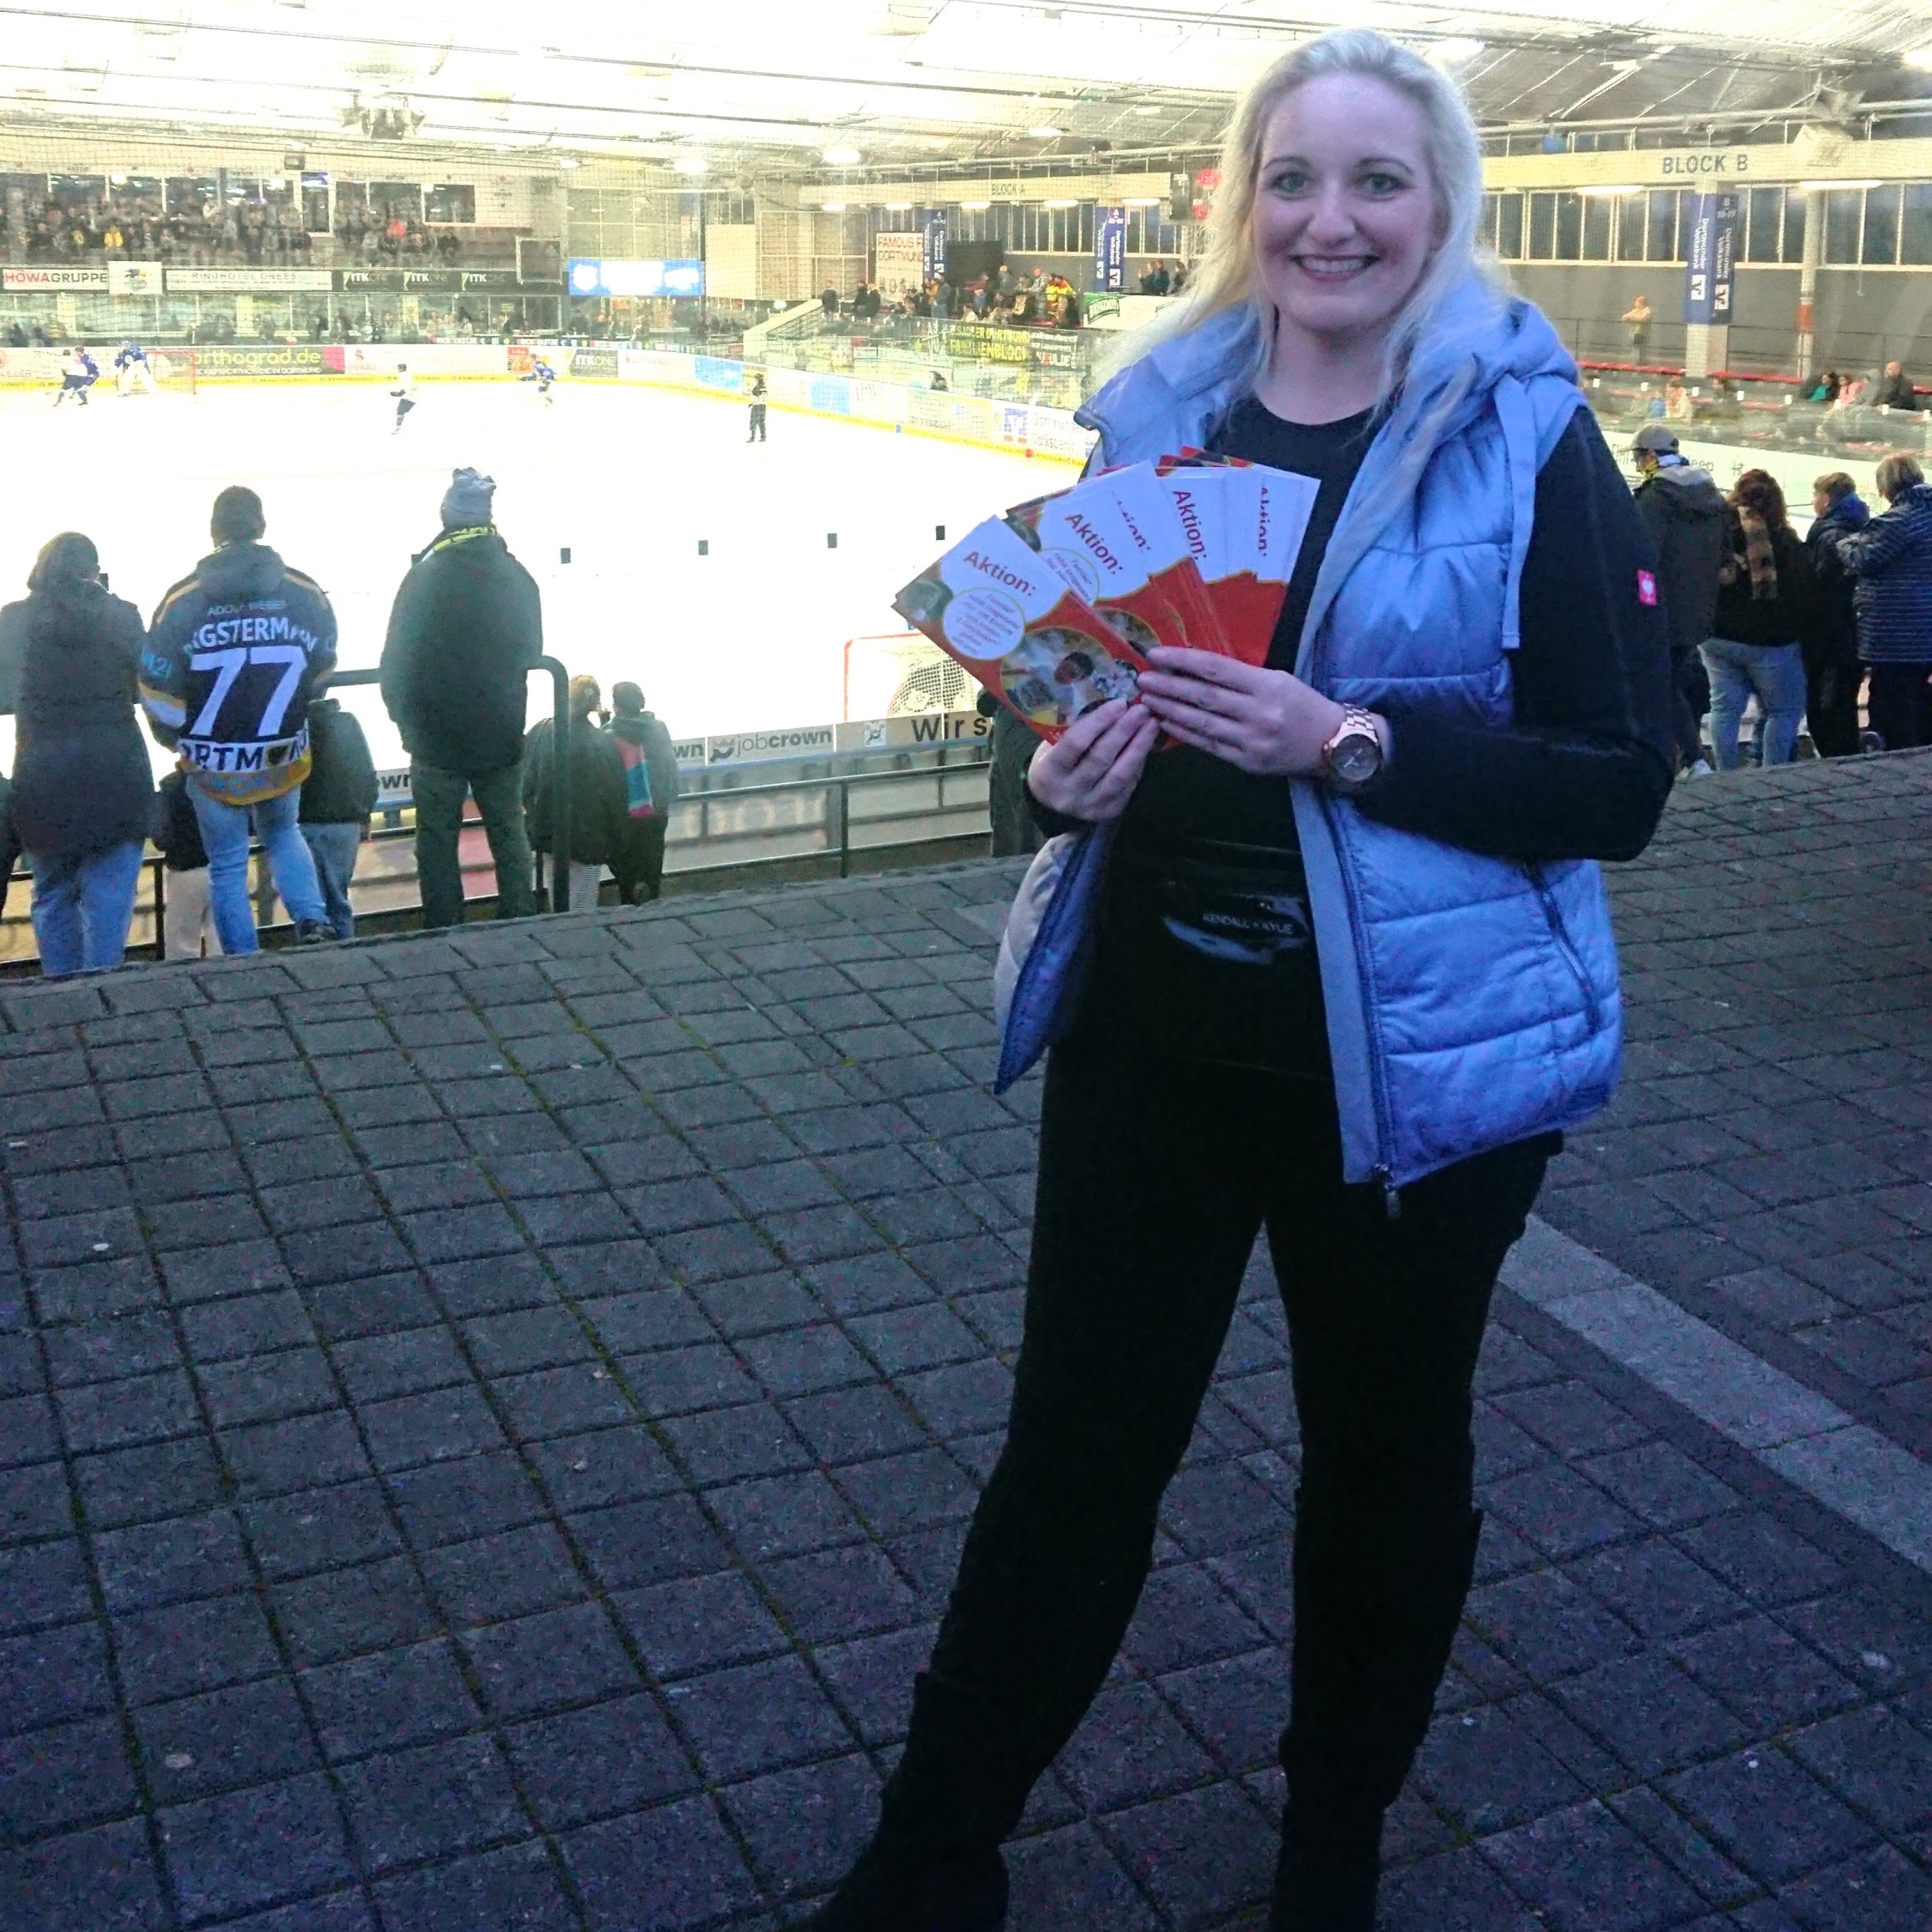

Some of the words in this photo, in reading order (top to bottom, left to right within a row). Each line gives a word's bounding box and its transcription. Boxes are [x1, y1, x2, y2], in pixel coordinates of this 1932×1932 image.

[1662, 155, 1726, 174] BLOCK
[1736, 154, 1748, 172] B
[991, 184, 1018, 196] BLOCK
[1019, 185, 1026, 195] A
[878, 236, 914, 248] FAMOUS
[1692, 227, 1703, 270] Volksbank
[1699, 217, 1710, 270] Dortmunder
[1722, 228, 1732, 279] Dortmunder
[1716, 236, 1725, 280] Volksbank
[192, 348, 321, 368] orthograd.de
[1173, 490, 1207, 560] Aktion:
[1065, 513, 1123, 575] Aktion:
[963, 550, 1036, 597] Aktion:
[207, 605, 246, 617] ADOLF
[191, 646, 309, 737] 77
[911, 714, 964, 742] Wir
[973, 715, 988, 737] s
[673, 744, 704, 758] wn
[736, 730, 832, 757] jobcrown
[1203, 913, 1250, 929] KENDALL
